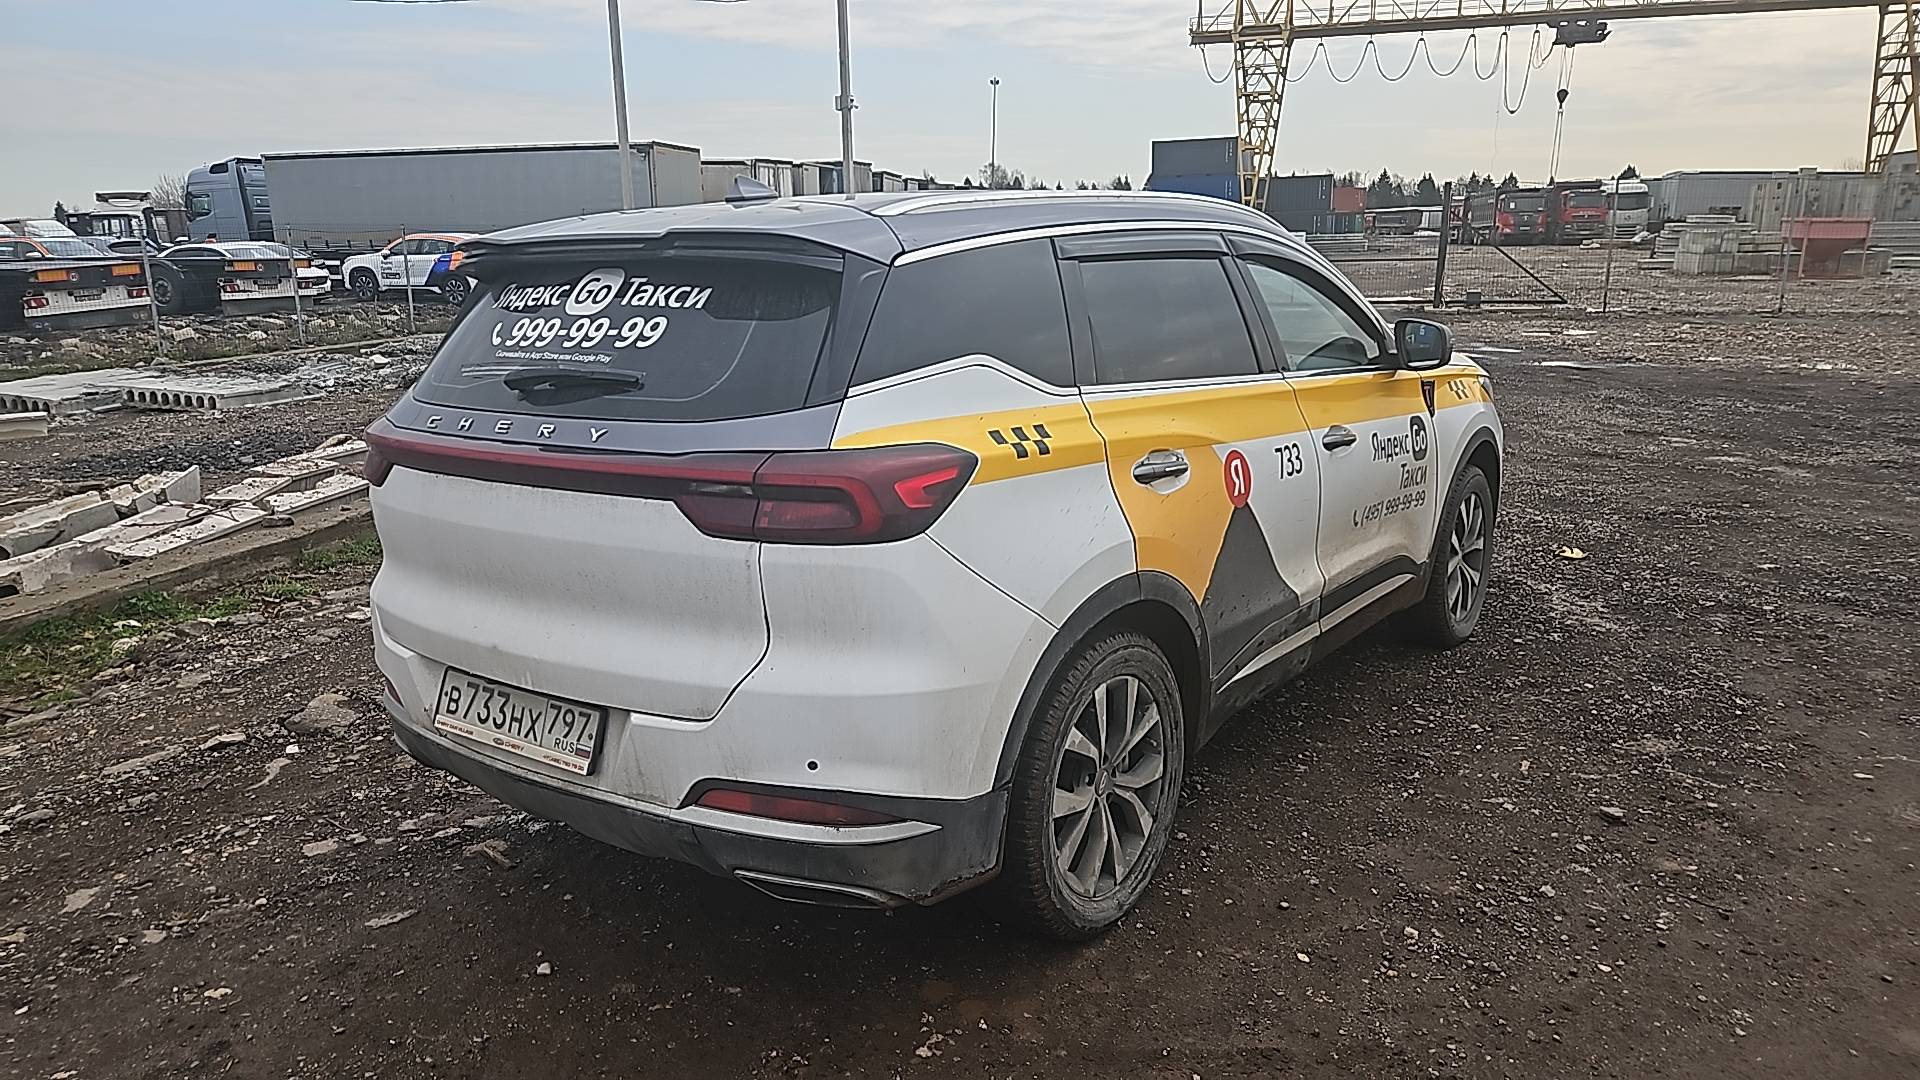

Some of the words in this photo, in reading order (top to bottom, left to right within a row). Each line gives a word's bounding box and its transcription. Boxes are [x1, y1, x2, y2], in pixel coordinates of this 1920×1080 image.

[492, 283, 570, 310] Яндекс
[573, 277, 614, 305] Go
[621, 277, 713, 309] Такси
[504, 316, 668, 348] 999-99-99
[572, 353, 596, 363] Google
[596, 354, 612, 363] Play
[426, 415, 608, 442] CHERY
[1371, 432, 1410, 462] Яндекс
[1412, 424, 1426, 452] Go
[1275, 442, 1302, 479] 733
[1400, 463, 1428, 490] Такси
[1230, 458, 1245, 497] Я
[1384, 490, 1426, 516] 999-99-99
[547, 703, 592, 742] 797
[553, 737, 575, 754] RUS
